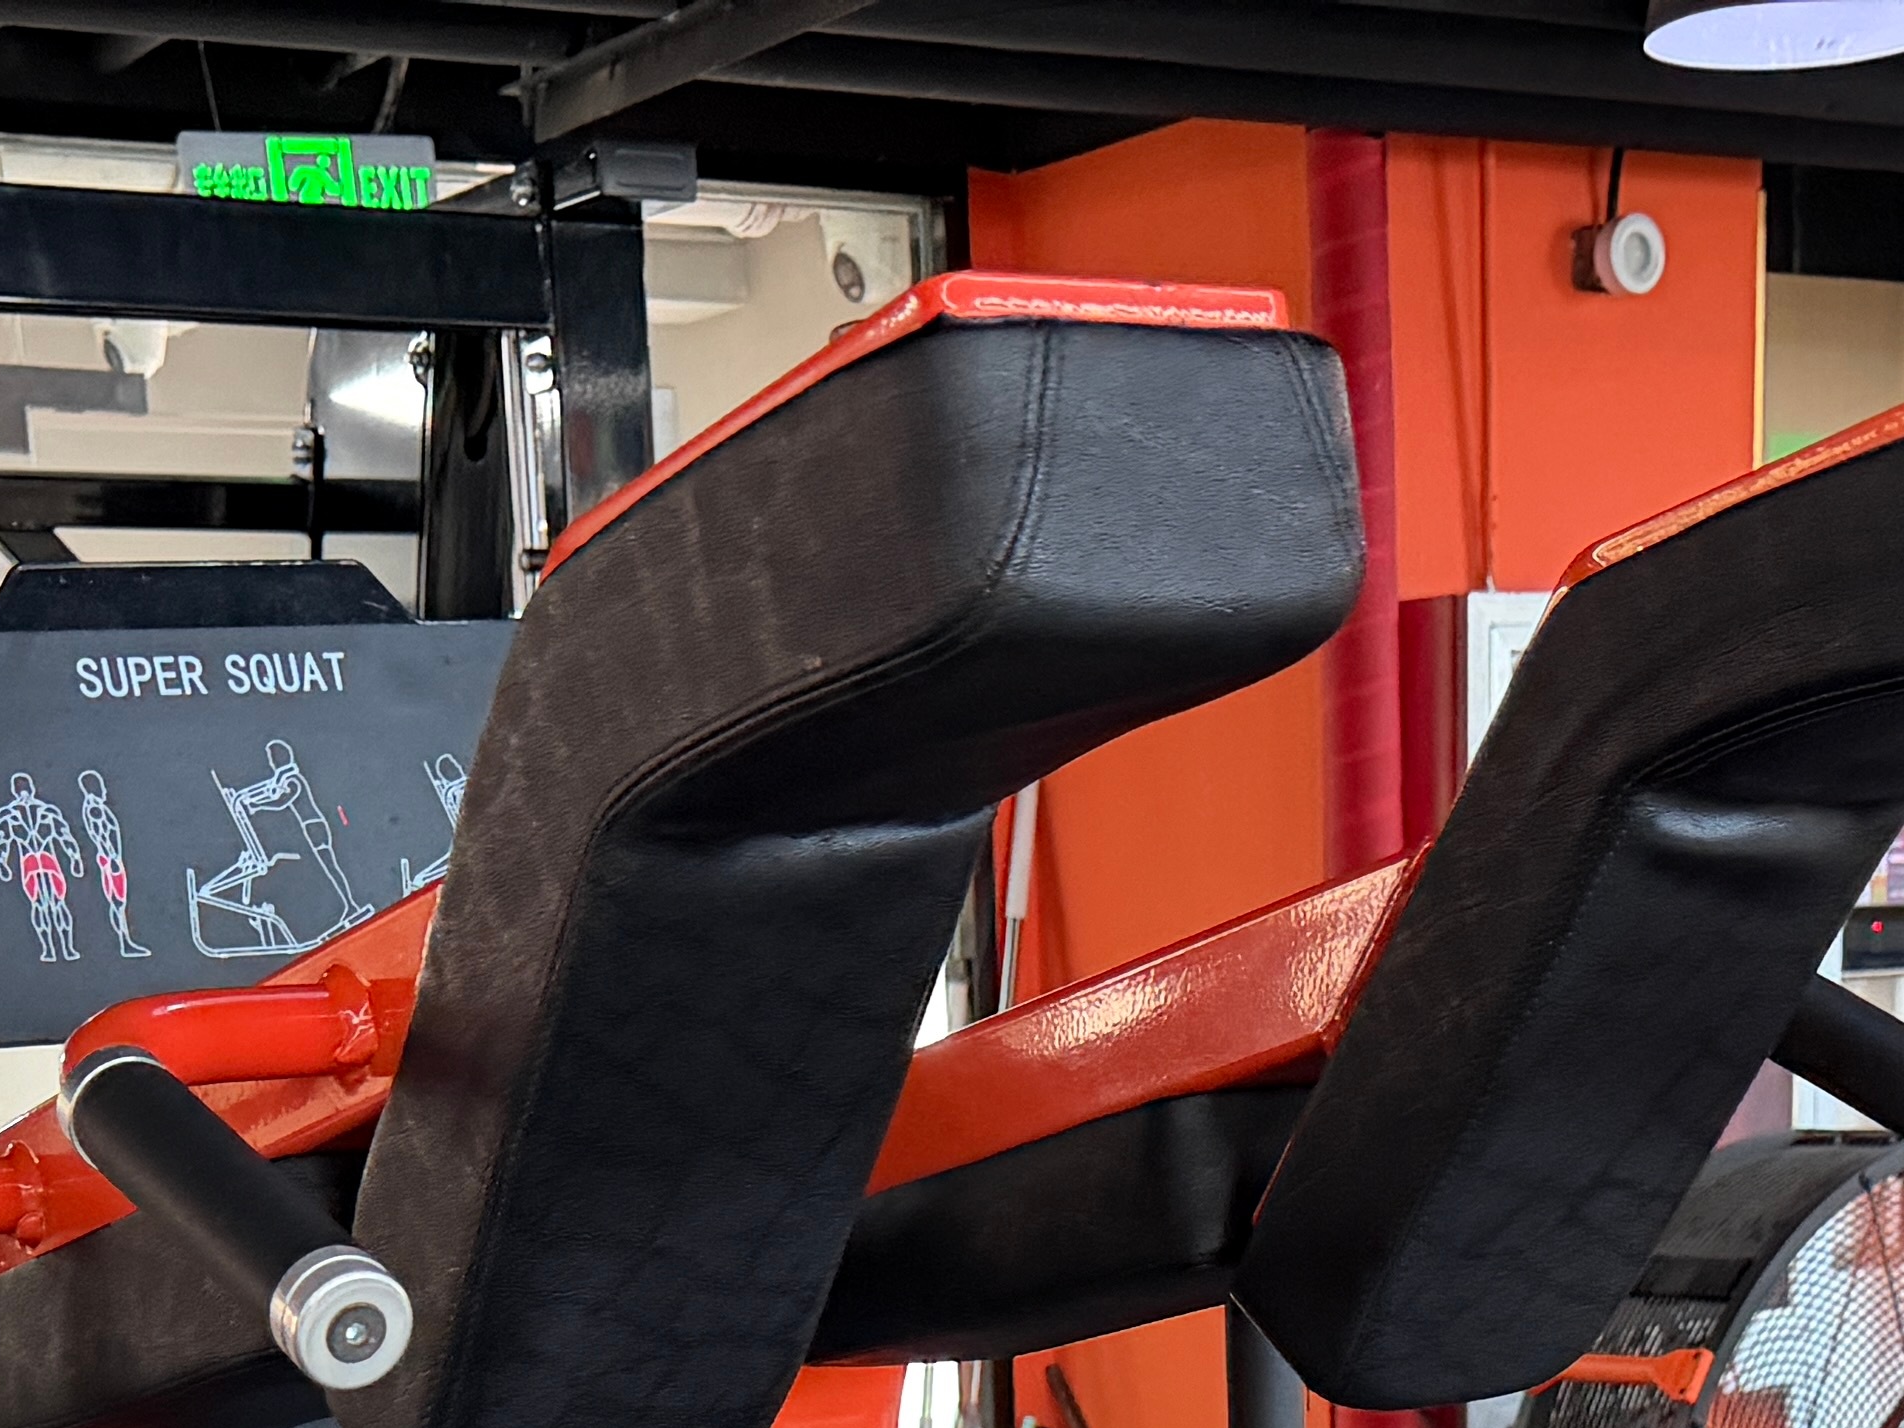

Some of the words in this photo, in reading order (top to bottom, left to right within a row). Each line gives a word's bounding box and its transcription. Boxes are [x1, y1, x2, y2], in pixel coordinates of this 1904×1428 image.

[358, 165, 431, 210] EXIT
[76, 655, 209, 698] SUPER
[224, 651, 345, 694] SQUAT
